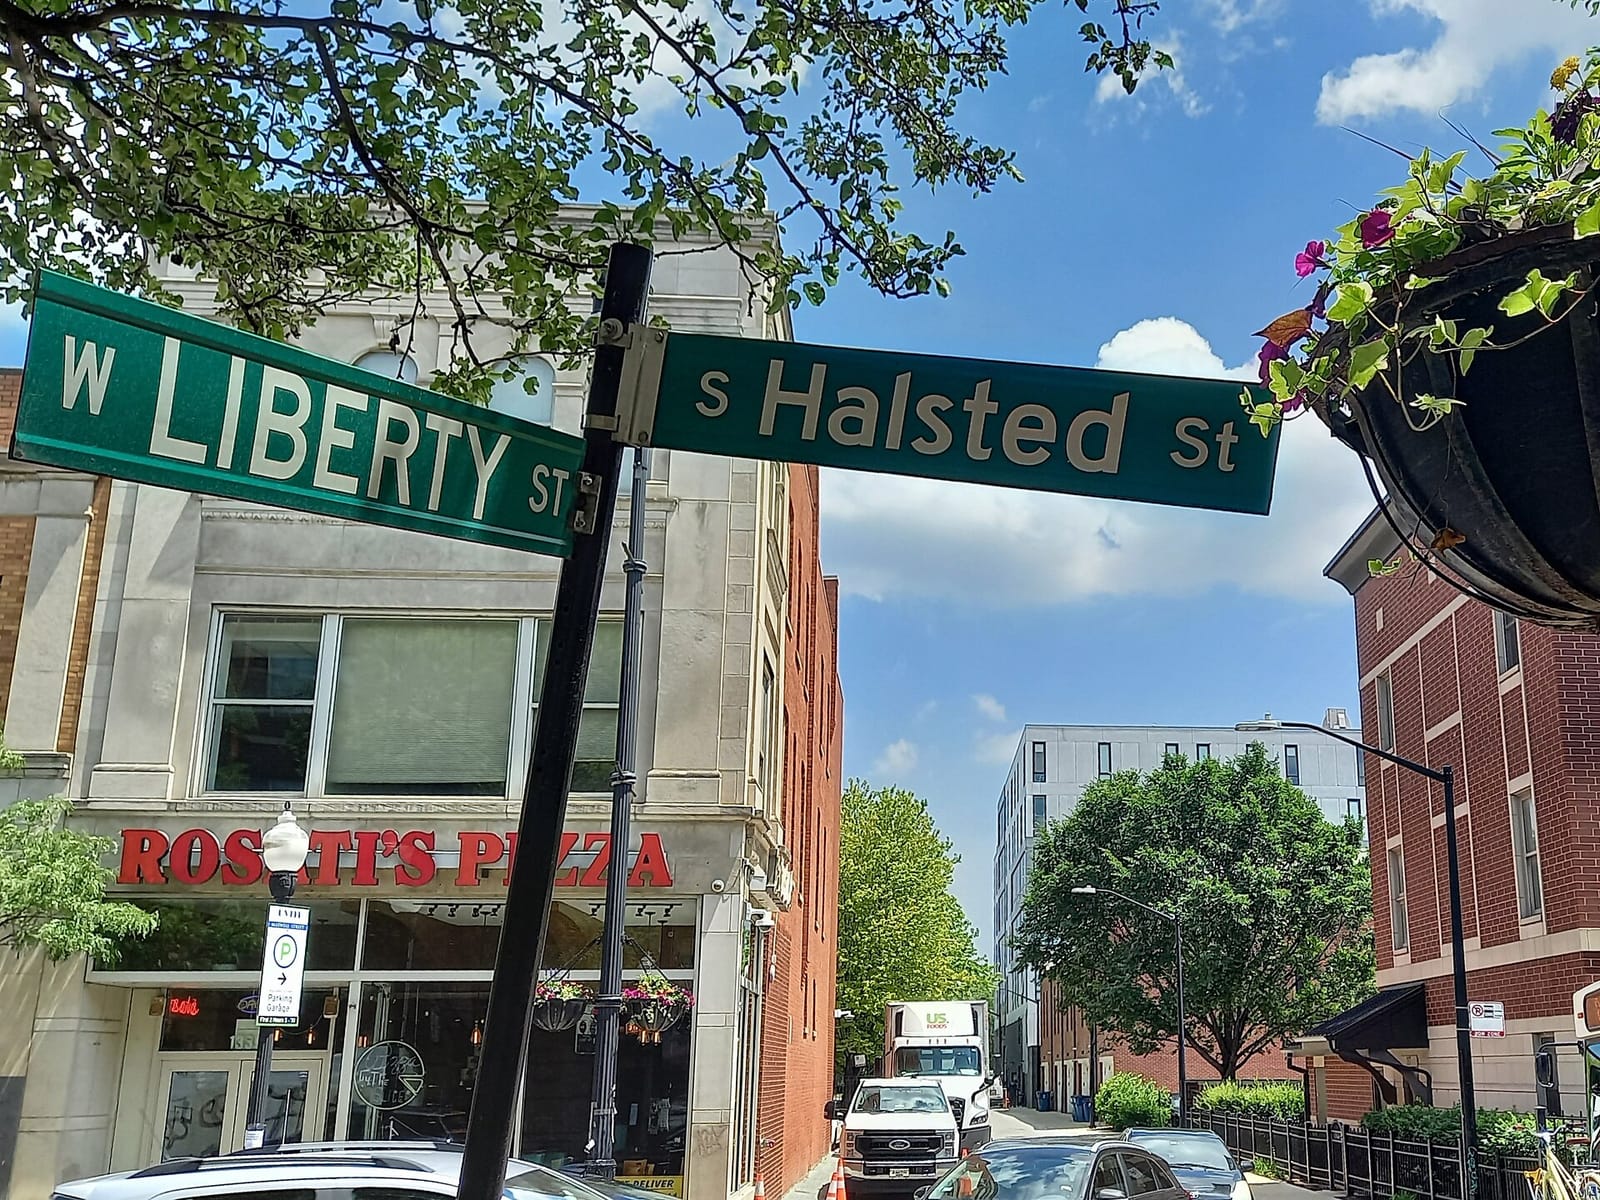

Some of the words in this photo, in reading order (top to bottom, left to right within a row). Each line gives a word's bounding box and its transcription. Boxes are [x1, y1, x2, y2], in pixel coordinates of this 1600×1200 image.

[62, 334, 116, 416] W
[149, 336, 512, 521] LIBERTY
[528, 463, 570, 517] ST
[694, 369, 731, 418] S
[758, 358, 1130, 476] Halsted
[1170, 416, 1240, 473] St
[116, 828, 436, 887] ROSTI'S
[266, 1003, 290, 1013] Garage
[267, 993, 293, 1004] Parking
[633, 1180, 674, 1188] DELIVER
